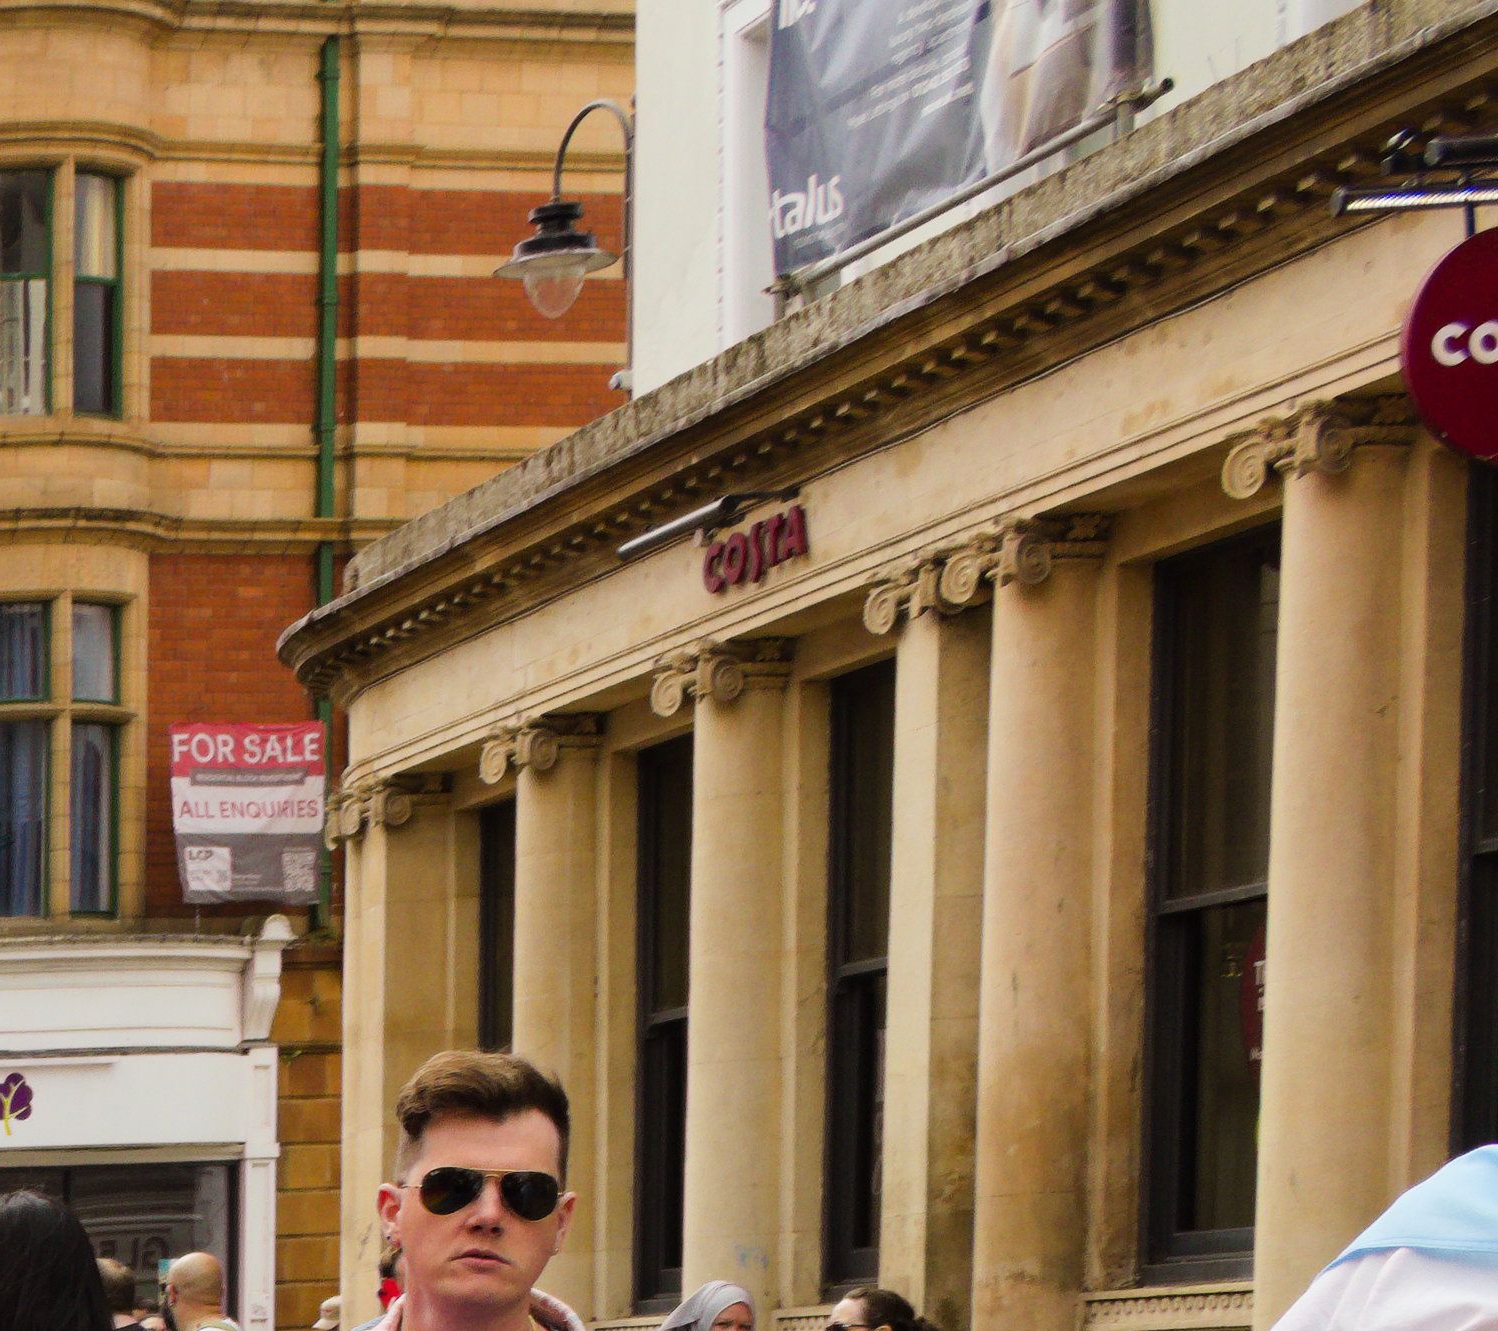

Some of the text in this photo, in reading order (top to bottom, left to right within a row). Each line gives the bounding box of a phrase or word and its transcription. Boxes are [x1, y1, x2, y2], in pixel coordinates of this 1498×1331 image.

[704, 505, 808, 594] COSTA
[172, 732, 321, 764] FOR SALE
[179, 799, 318, 819] ALL ENQUIRIES
